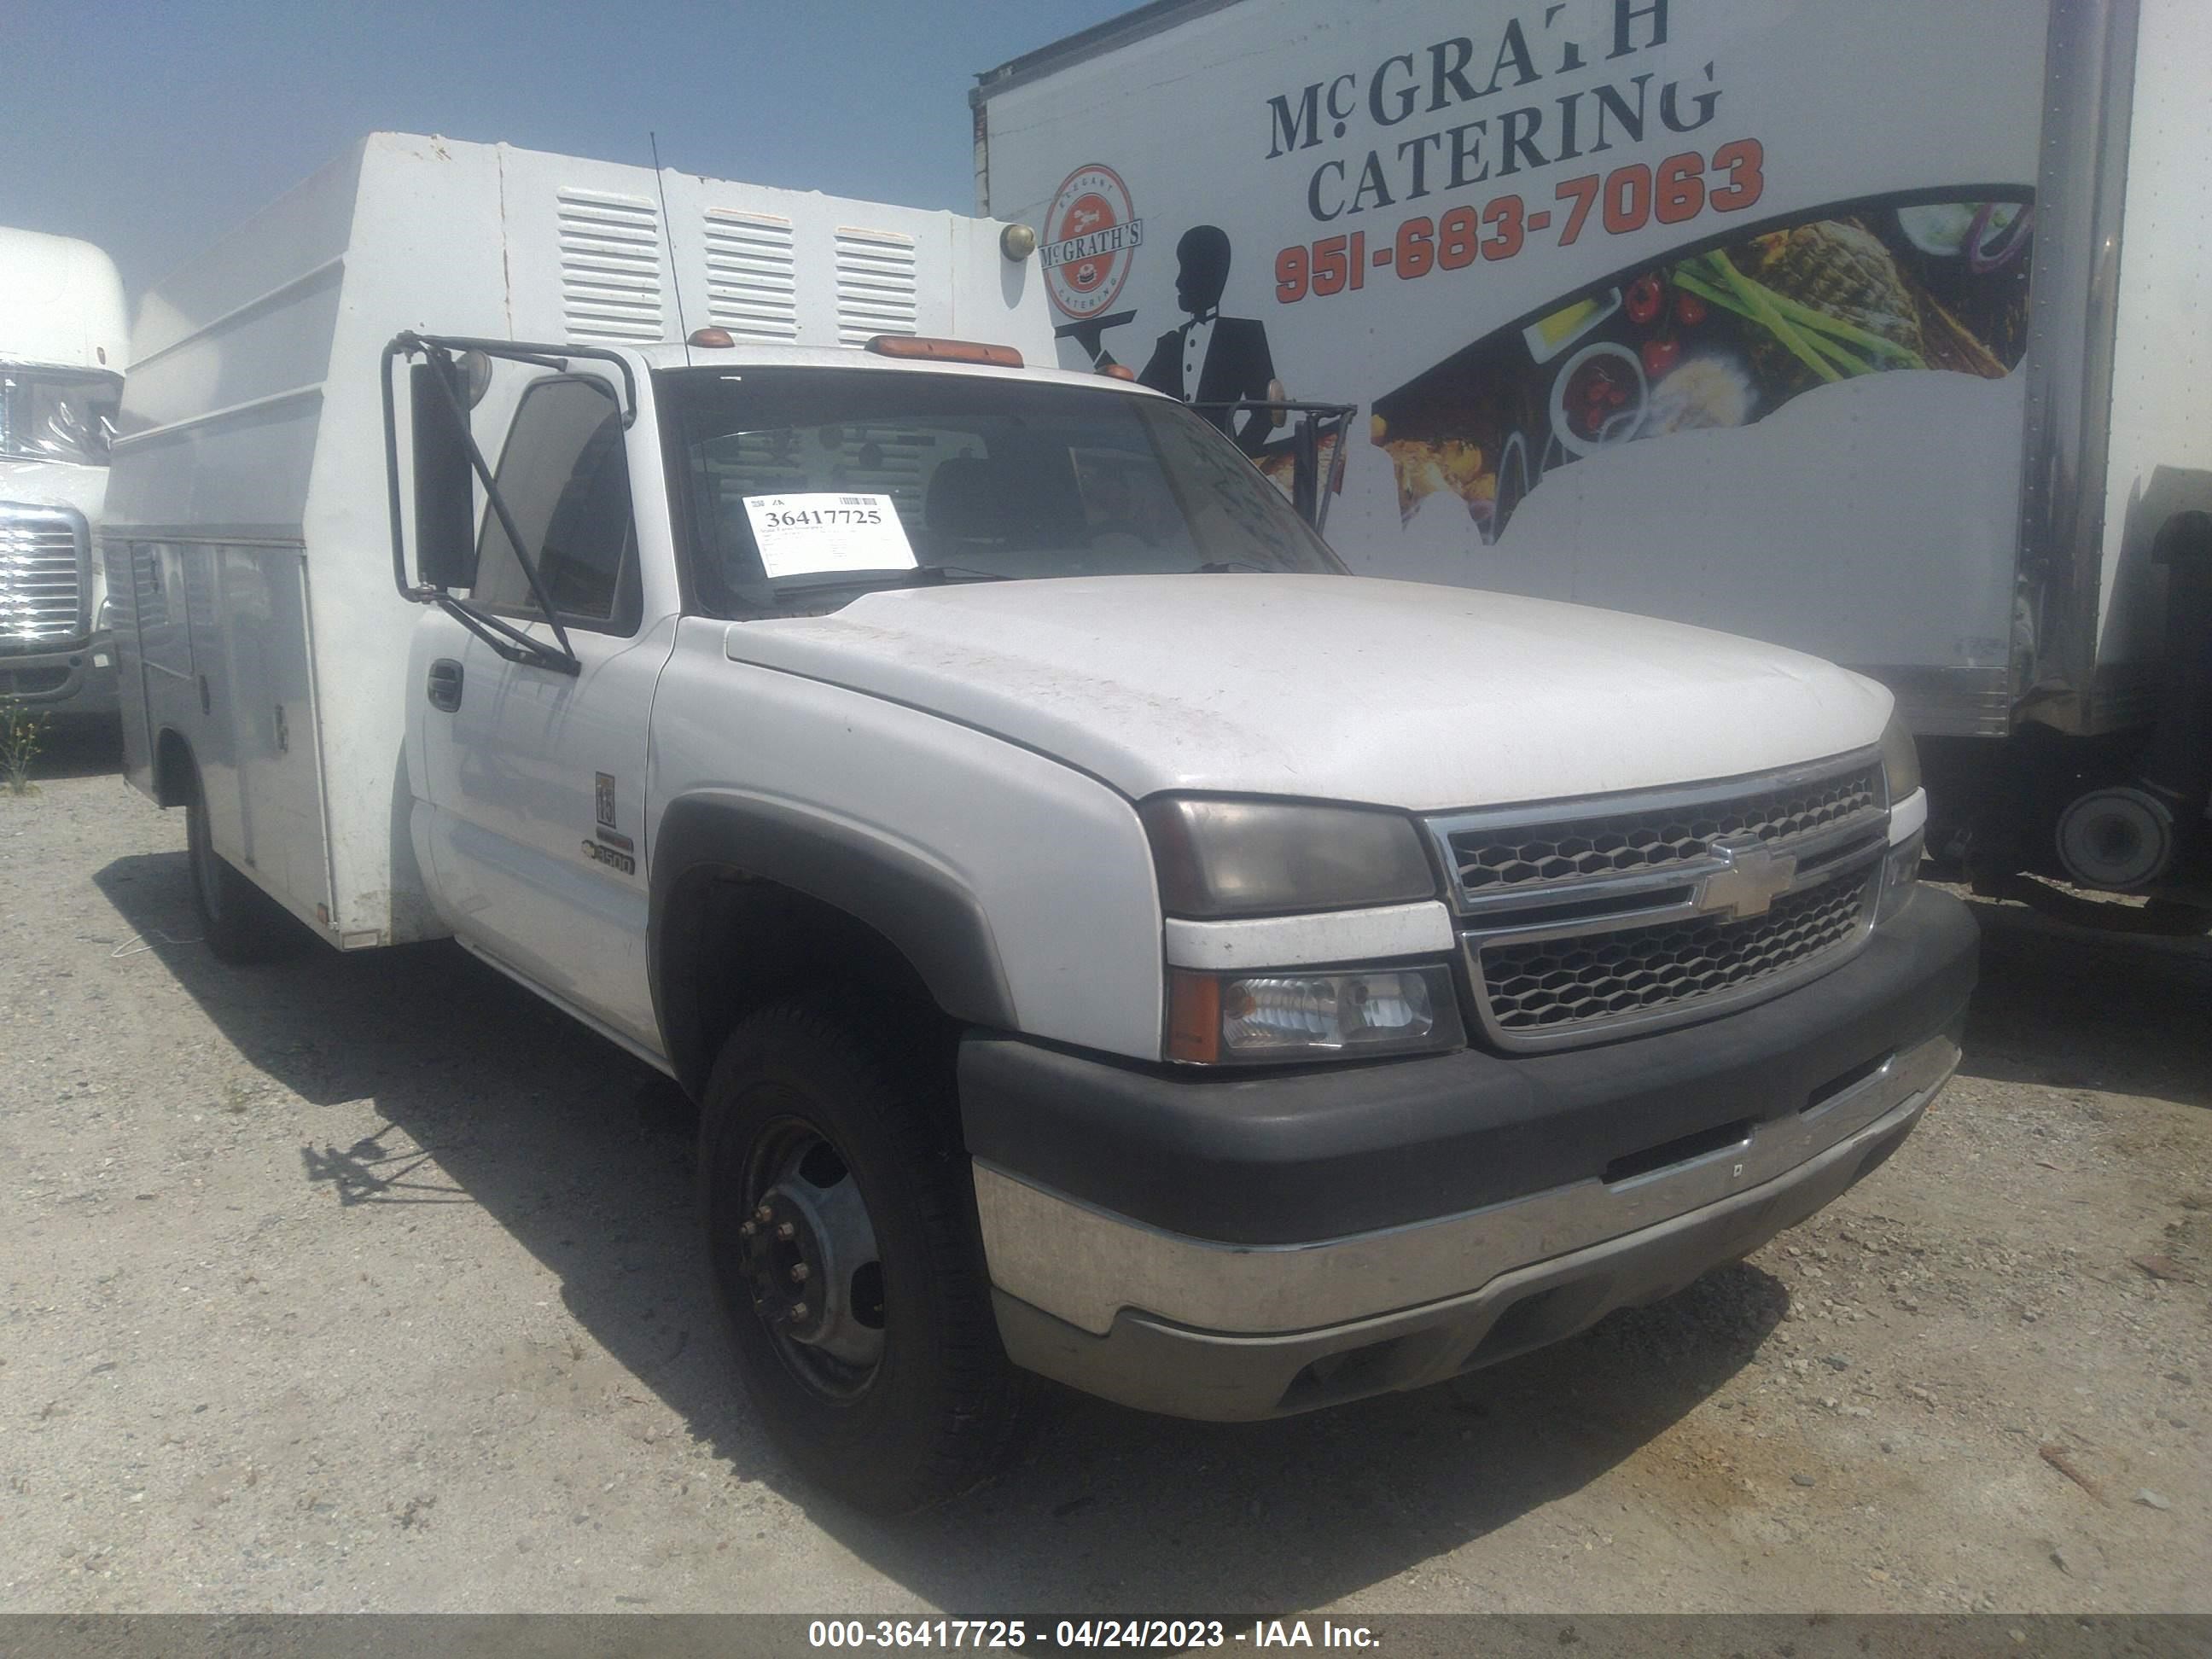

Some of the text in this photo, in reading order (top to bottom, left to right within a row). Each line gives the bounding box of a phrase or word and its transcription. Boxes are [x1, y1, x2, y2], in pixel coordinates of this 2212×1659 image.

[1307, 61, 1723, 222] CATERING
[1058, 177, 1114, 209] ELEGANT
[1275, 137, 1765, 305] 951-683-7063
[1058, 277, 1117, 309] CATERING
[765, 510, 882, 527] 36417725
